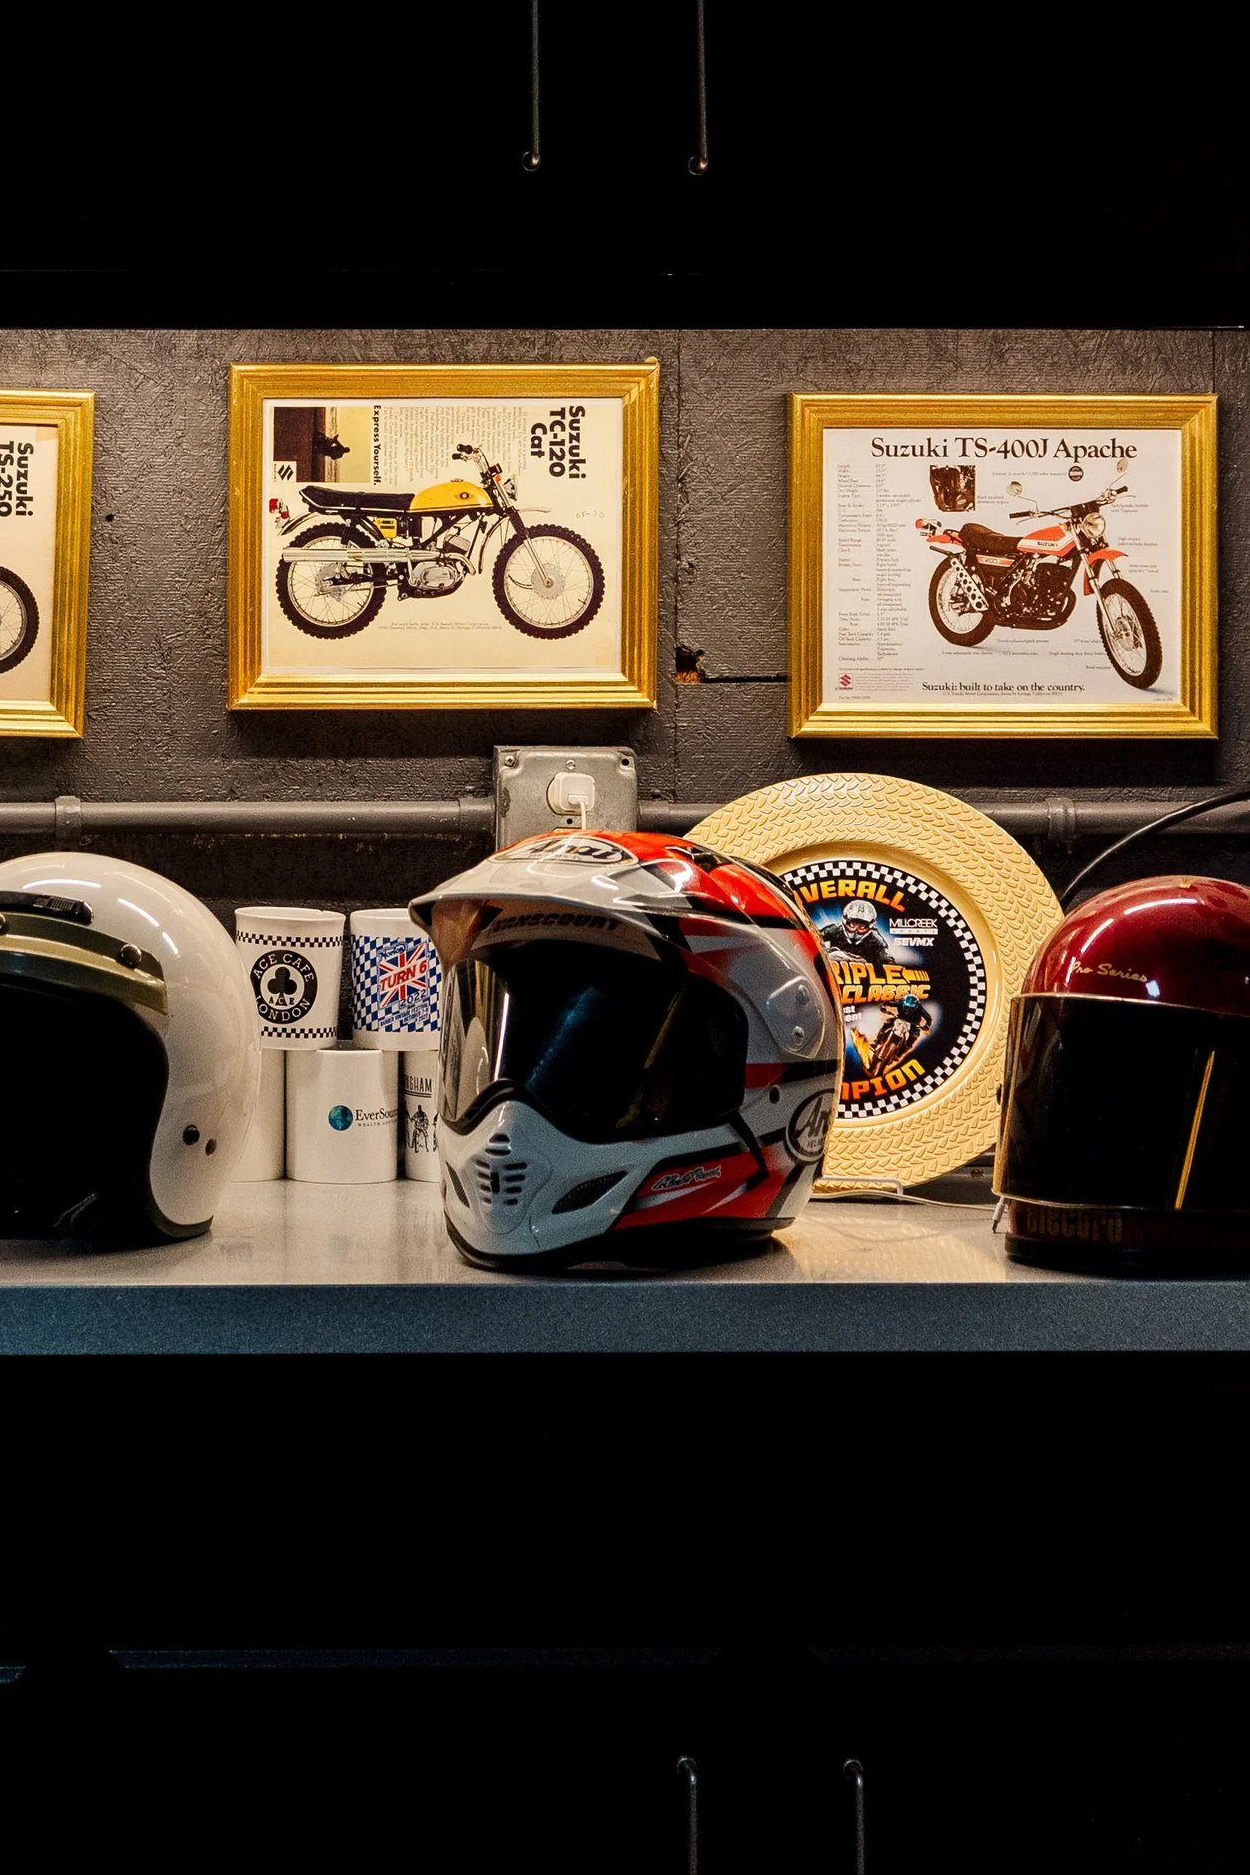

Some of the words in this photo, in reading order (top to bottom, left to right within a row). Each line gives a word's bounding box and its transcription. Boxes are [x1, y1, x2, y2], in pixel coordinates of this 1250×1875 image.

[373, 404, 382, 449] Express
[529, 422, 548, 459] Cat
[548, 406, 567, 479] TC-120
[568, 405, 587, 480] Suzuki
[871, 436, 948, 458] Suzuki
[953, 436, 1048, 458] TS-400J
[1053, 437, 1137, 463] Apache
[14, 442, 34, 517] Suzuki
[372, 450, 382, 486] Yourself.
[922, 682, 957, 691] Suzuki:
[959, 682, 981, 691] built
[983, 683, 993, 691] to
[994, 682, 1014, 691] take
[1031, 682, 1045, 691] the
[1047, 683, 1085, 692] country.
[793, 878, 905, 913] VERALL
[889, 918, 938, 928] MILLCREEK
[893, 937, 935, 947] SEVMX
[253, 953, 278, 979] ACE
[282, 953, 315, 982] CAFE
[380, 964, 416, 992] TURN
[419, 960, 427, 974] 6
[830, 960, 908, 985] RIPLE
[1097, 963, 1148, 983] Series
[268, 996, 295, 1006] ACE
[399, 989, 426, 1008] 2022
[842, 984, 931, 1005] CLASSIC
[256, 995, 310, 1022] LONDON
